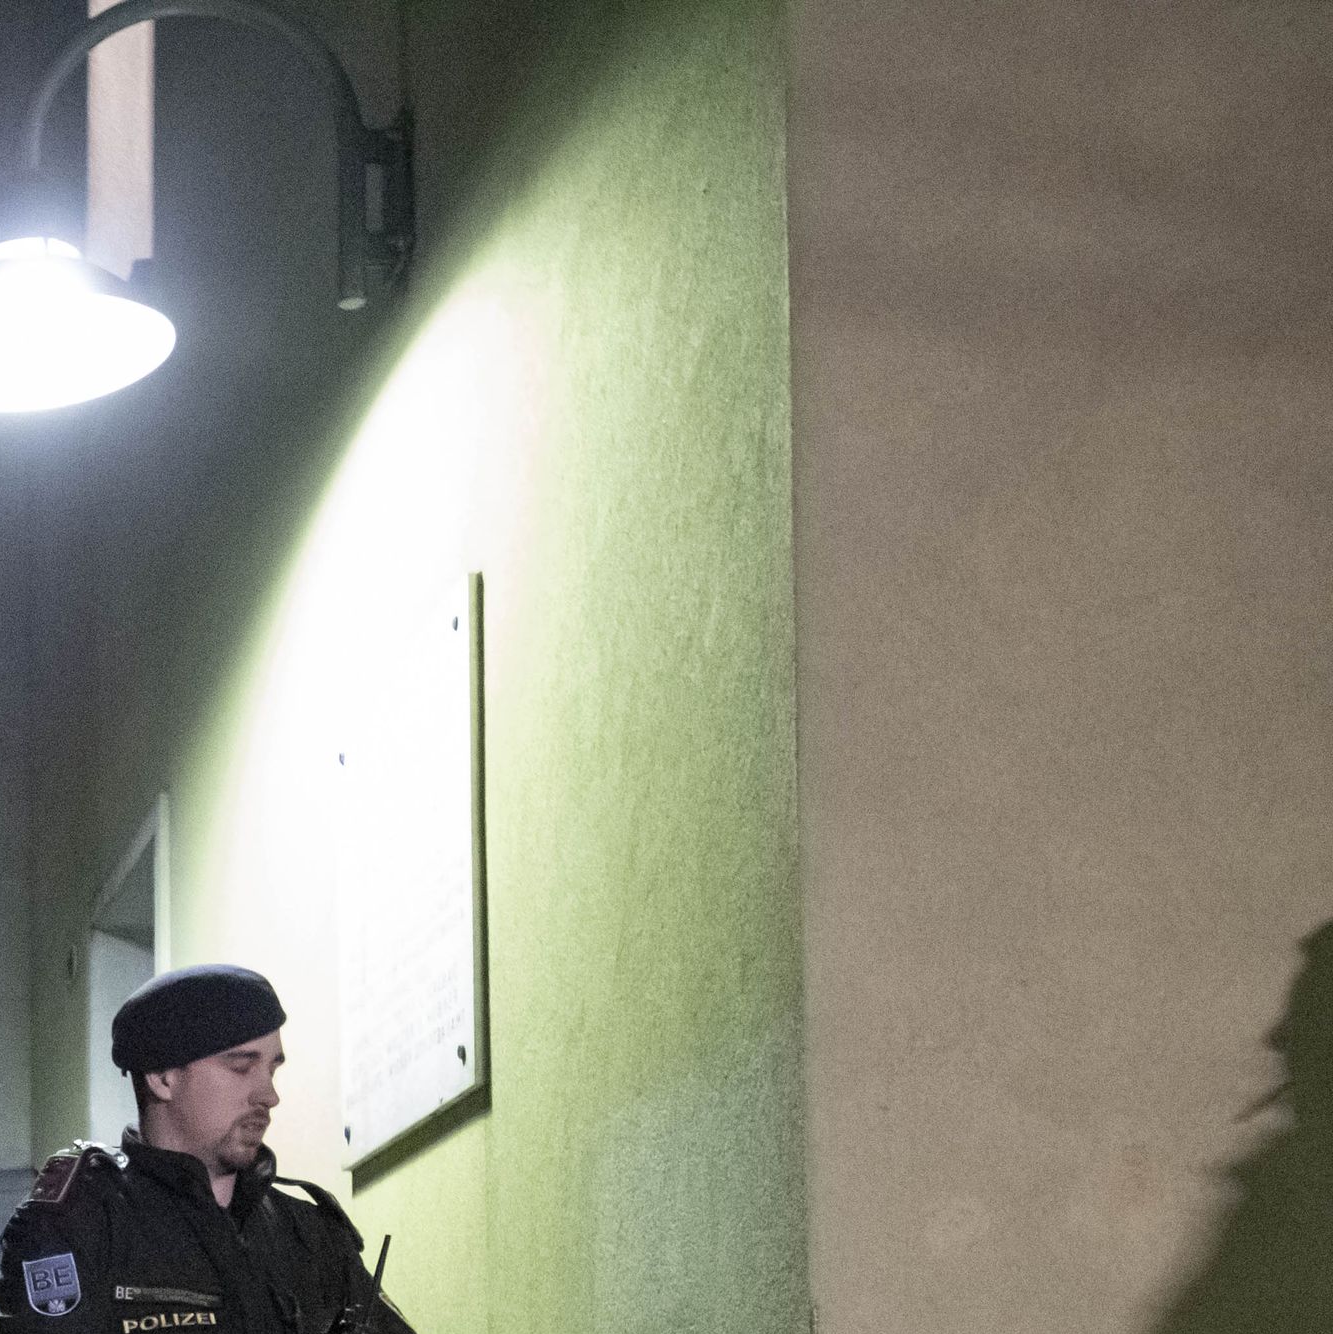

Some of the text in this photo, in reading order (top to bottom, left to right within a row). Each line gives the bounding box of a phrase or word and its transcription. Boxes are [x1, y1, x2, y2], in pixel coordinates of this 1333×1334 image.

[33, 1264, 71, 1292] BE
[114, 1285, 134, 1301] BE
[122, 1312, 217, 1334] POLIZEI
